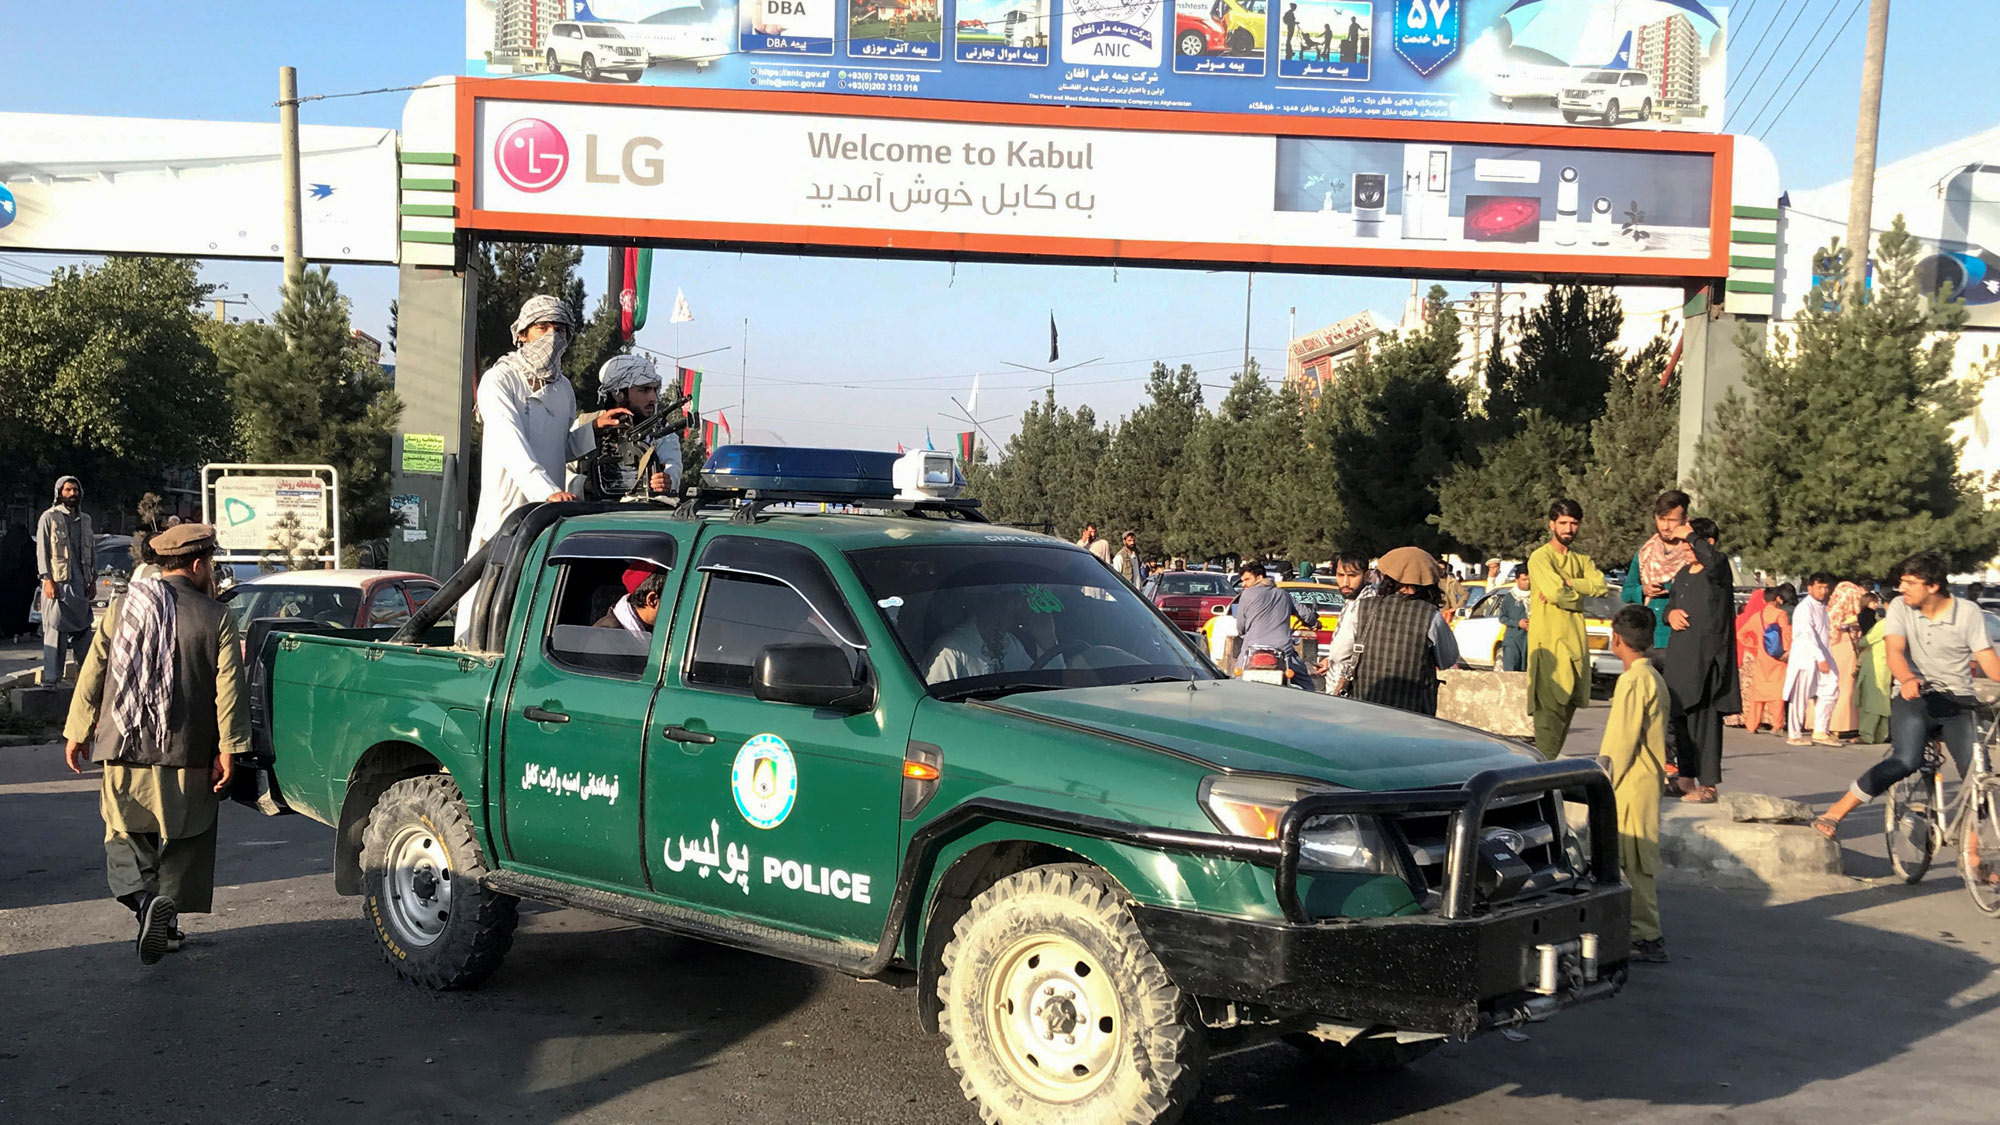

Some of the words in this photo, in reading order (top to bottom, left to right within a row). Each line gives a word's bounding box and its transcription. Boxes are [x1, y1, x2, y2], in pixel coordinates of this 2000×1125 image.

[768, 1, 806, 15] DBA
[1407, 0, 1450, 29] ۵۷
[766, 37, 788, 48] DBA
[1402, 33, 1431, 44] خدمت
[1432, 34, 1451, 47] سال
[862, 43, 887, 55] سوزی
[911, 46, 928, 57] بیمه
[965, 47, 995, 60] تجارتی
[997, 48, 1020, 61] اموال
[1093, 42, 1131, 58] ANIC
[1022, 51, 1039, 62] بیمه
[1229, 61, 1245, 72] بیمه
[1302, 64, 1323, 76] سفر
[1326, 66, 1349, 77] بیمه
[874, 72, 888, 81] 700
[1065, 67, 1089, 80] افغان
[1091, 69, 1109, 82] ملی
[1111, 72, 1129, 83] بیمه
[1131, 71, 1159, 85] شرکت
[807, 131, 951, 165] Welcome
[962, 142, 996, 166] to
[1007, 140, 1094, 170] Kabul
[585, 133, 665, 187] LG
[806, 171, 884, 209] آمدید
[889, 173, 973, 213] خوش
[982, 183, 1056, 216] کابل
[1064, 190, 1095, 219] به
[522, 762, 540, 790] کابل
[664, 818, 749, 896] پولیس
[763, 856, 871, 905] POLICE
